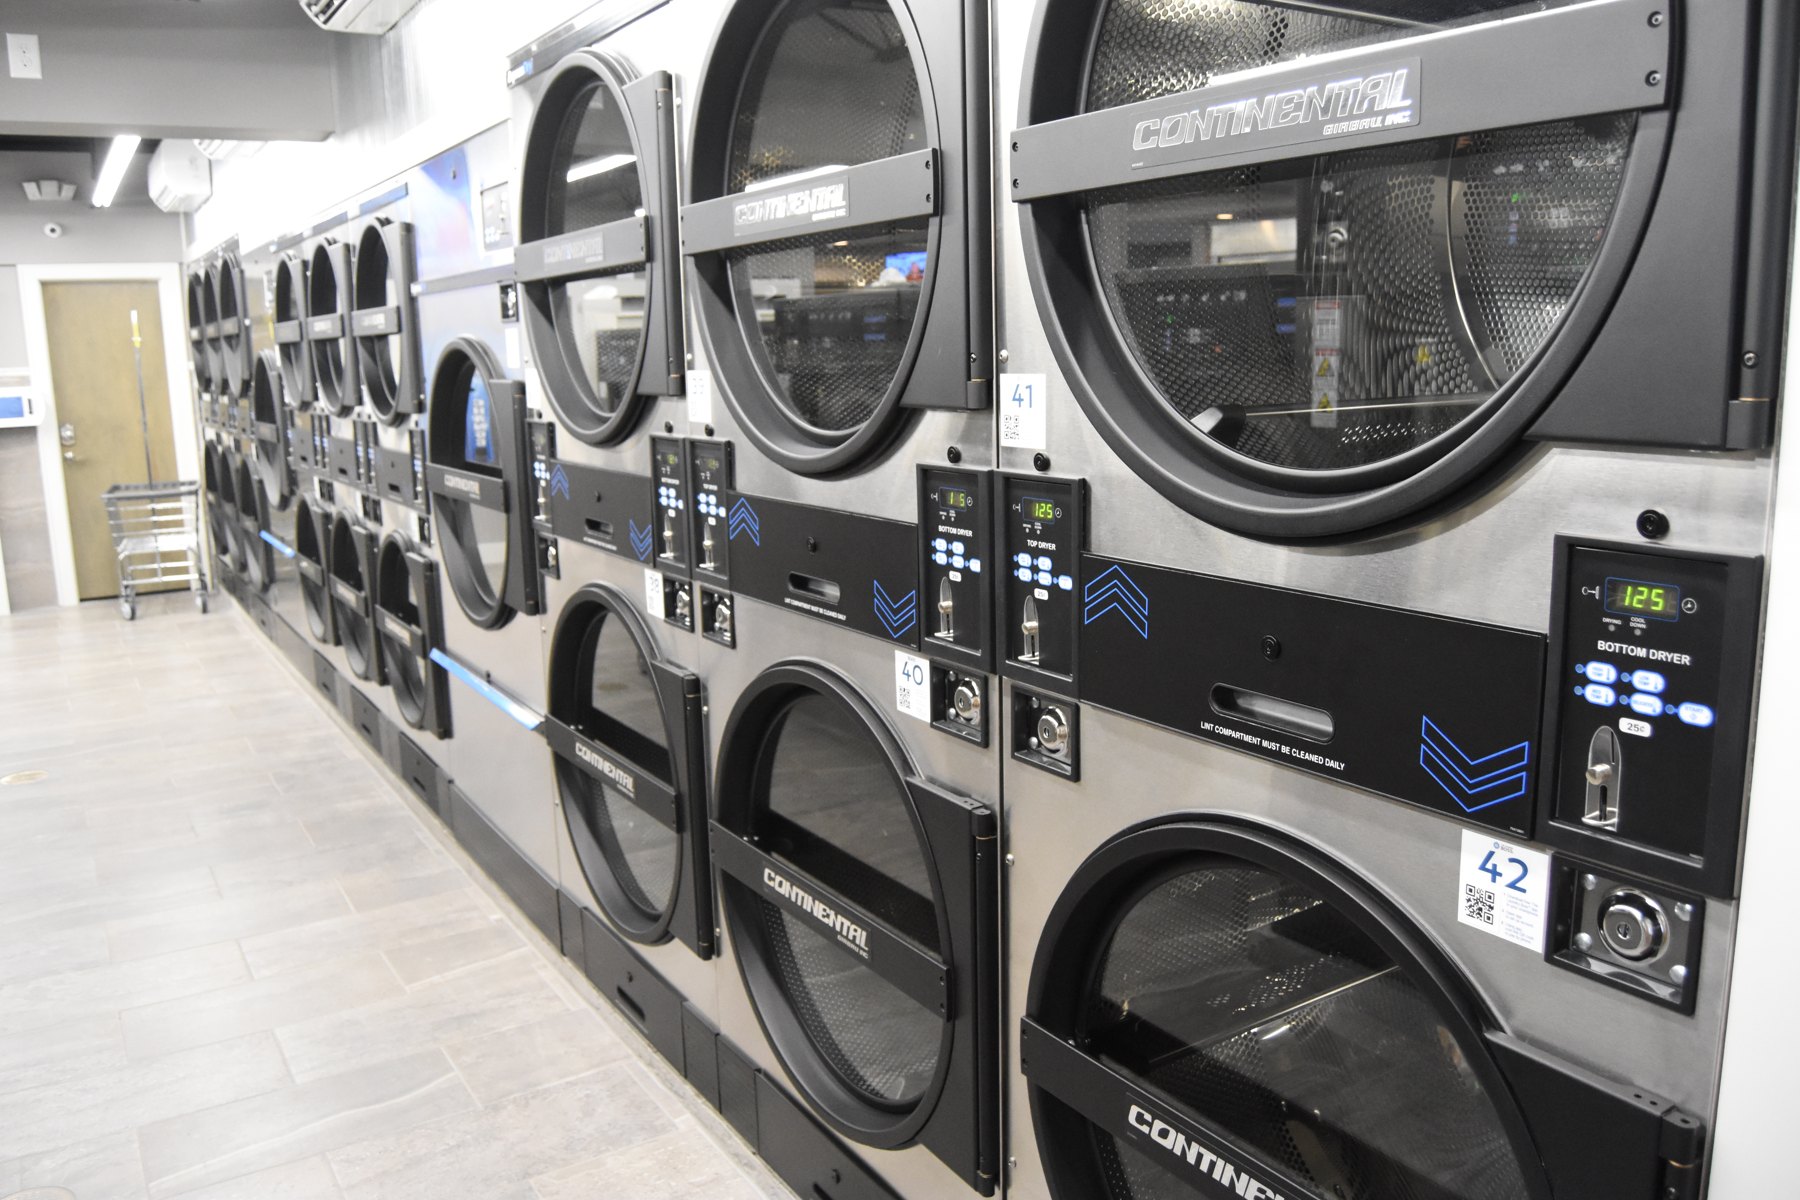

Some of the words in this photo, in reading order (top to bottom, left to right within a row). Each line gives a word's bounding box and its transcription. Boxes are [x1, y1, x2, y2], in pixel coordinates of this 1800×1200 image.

[1132, 69, 1412, 151] CONTINENTAL
[1012, 384, 1032, 408] 41
[1034, 503, 1053, 519] 125
[938, 525, 957, 535] BOTTOM
[957, 528, 973, 537] DRYER
[1027, 539, 1037, 548] TOP
[1038, 541, 1056, 551] DRYER
[1624, 585, 1664, 611] 125
[1597, 640, 1647, 658] BOTTOM
[1649, 649, 1692, 666] DRYER
[902, 661, 923, 685] 40
[1200, 721, 1214, 732] LINT
[1214, 725, 1261, 746] COMPARTMENT
[1262, 739, 1280, 751] MUST
[1281, 745, 1290, 755] BE
[1291, 748, 1324, 765] CLEANED
[1325, 758, 1345, 771] DAILY
[1478, 850, 1528, 893] 42
[763, 867, 869, 951] CONTINENTAL
[1128, 1104, 1285, 1200] CONTINE
